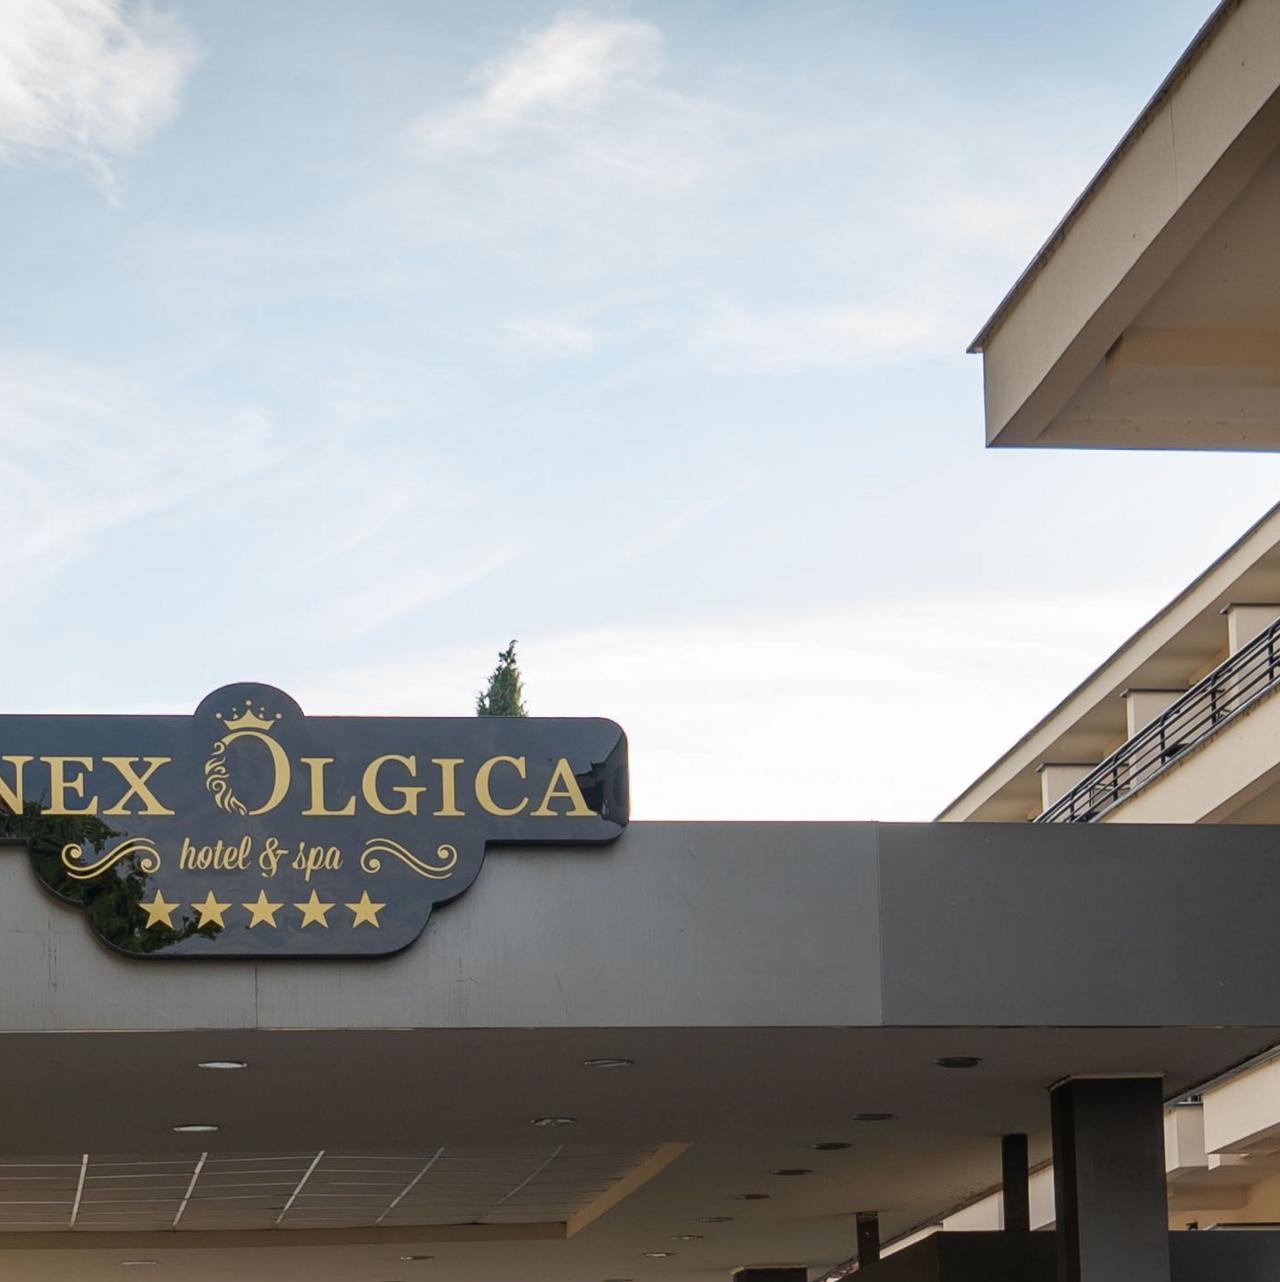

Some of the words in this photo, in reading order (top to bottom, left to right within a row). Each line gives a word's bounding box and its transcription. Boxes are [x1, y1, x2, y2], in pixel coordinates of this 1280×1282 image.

[204, 730, 600, 817] OLGICA
[178, 835, 253, 872] hotel
[259, 839, 289, 878] &
[292, 844, 344, 883] spa
